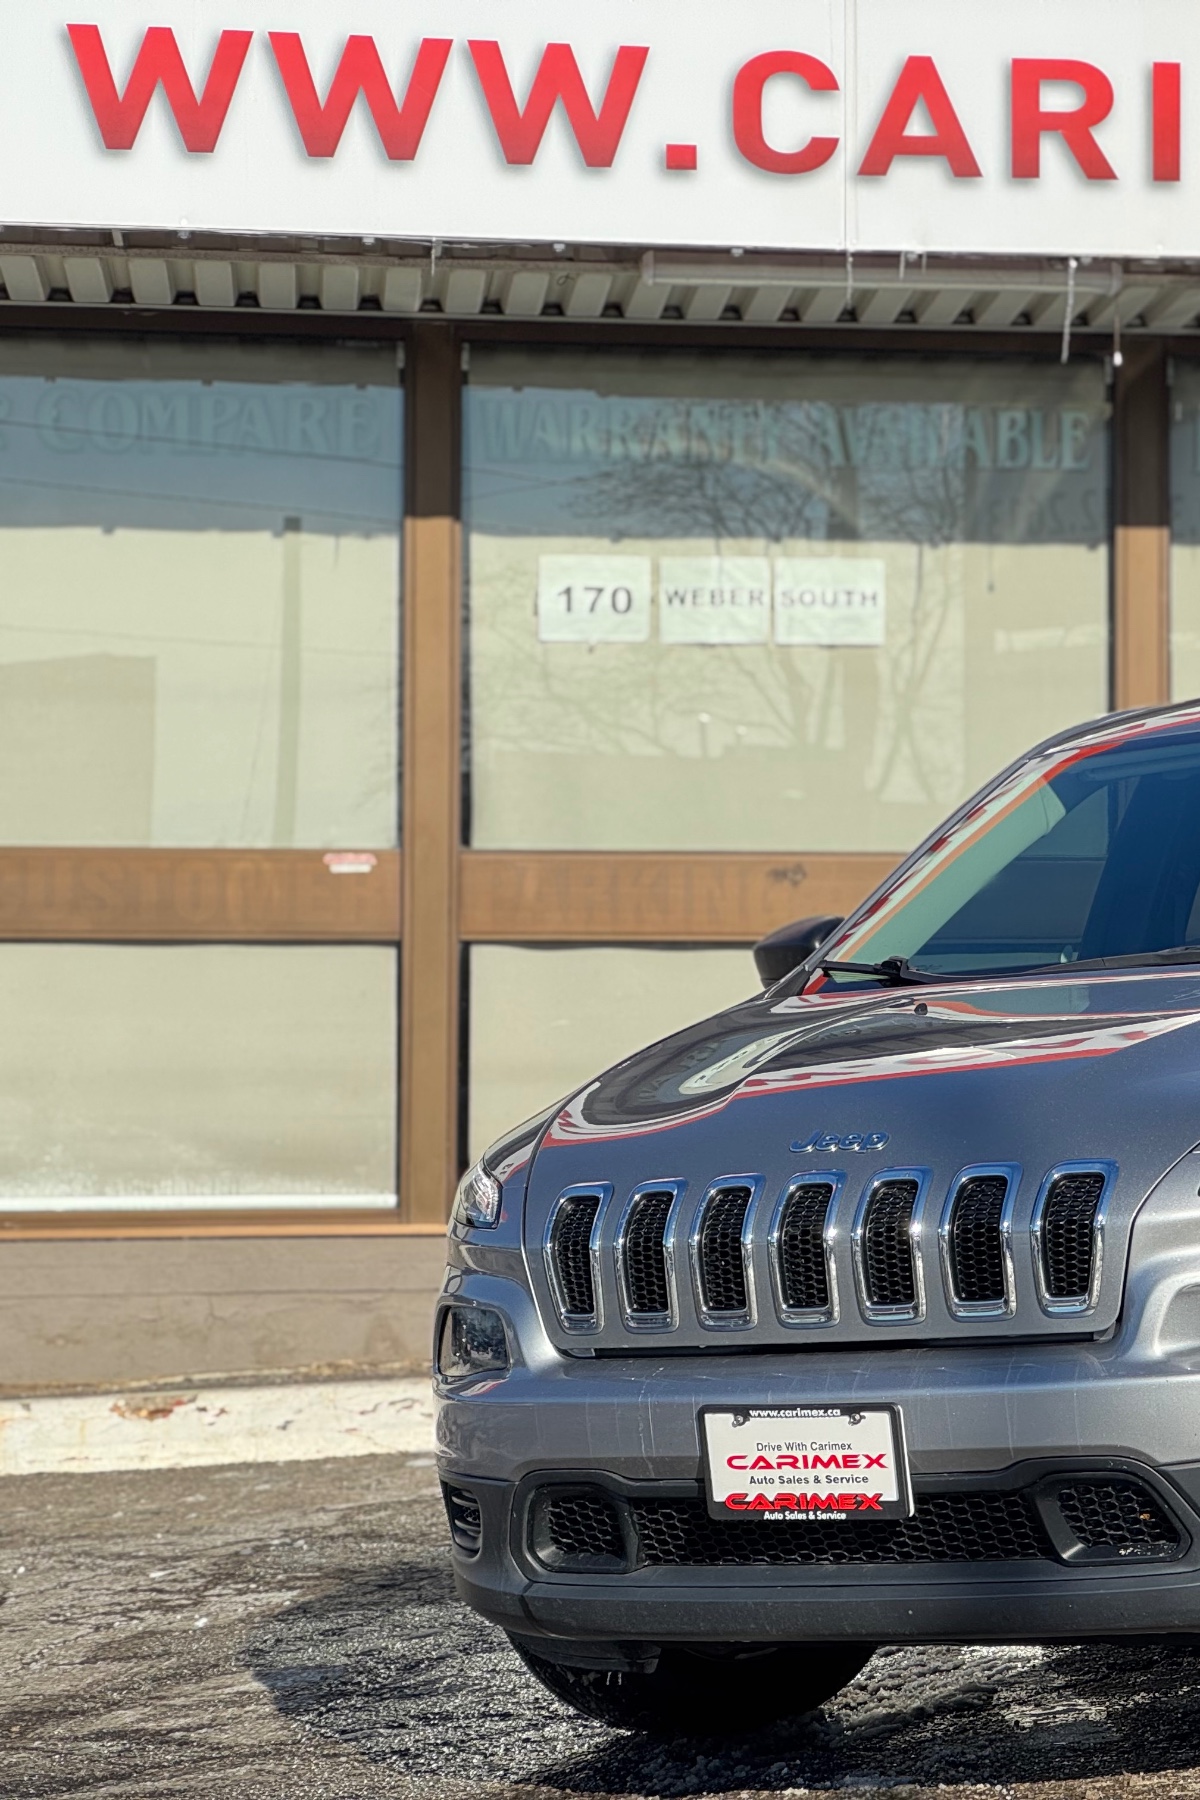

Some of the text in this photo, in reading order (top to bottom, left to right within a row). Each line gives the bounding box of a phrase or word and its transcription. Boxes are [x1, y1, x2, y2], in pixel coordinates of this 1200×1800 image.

[37, 387, 382, 457] COMPARE
[557, 586, 878, 613] 170 WEBER SOUTH
[789, 1129, 890, 1154] Jeep
[749, 1408, 841, 1418] www.carimex.ca
[756, 1441, 853, 1451] Drive With Carimex
[726, 1453, 889, 1470] CARIMEX
[749, 1474, 869, 1485] Auto Sales & Service
[724, 1493, 884, 1510] CARIMEX
[763, 1511, 847, 1520] Auto Sales & Service
